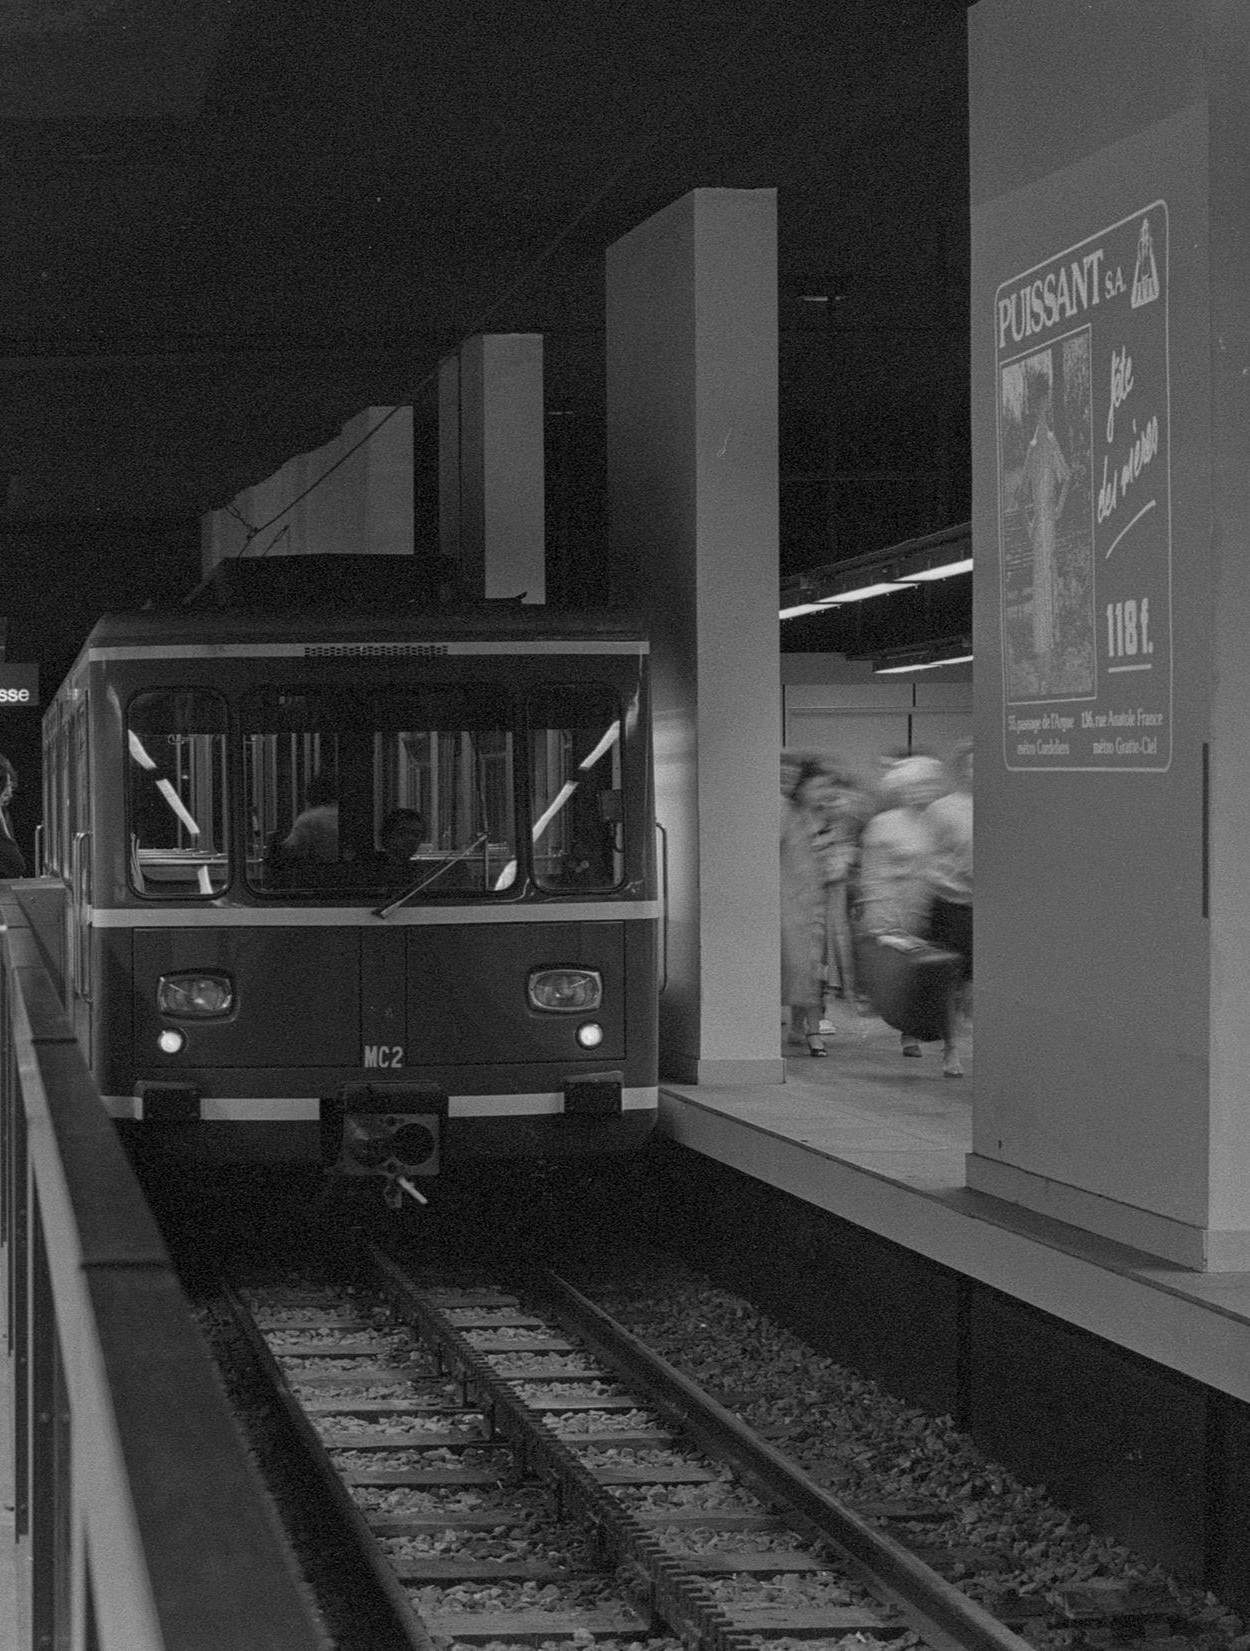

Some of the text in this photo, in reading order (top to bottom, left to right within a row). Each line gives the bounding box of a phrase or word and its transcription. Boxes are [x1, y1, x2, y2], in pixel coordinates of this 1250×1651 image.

[997, 248, 1104, 349] PUISSANT
[1097, 455, 1118, 524] des
[1095, 715, 1107, 728] rue
[1107, 708, 1136, 727] Anatole
[1137, 707, 1163, 727] France
[1036, 738, 1070, 755] Cordeliers
[364, 1045, 403, 1068] MC2
